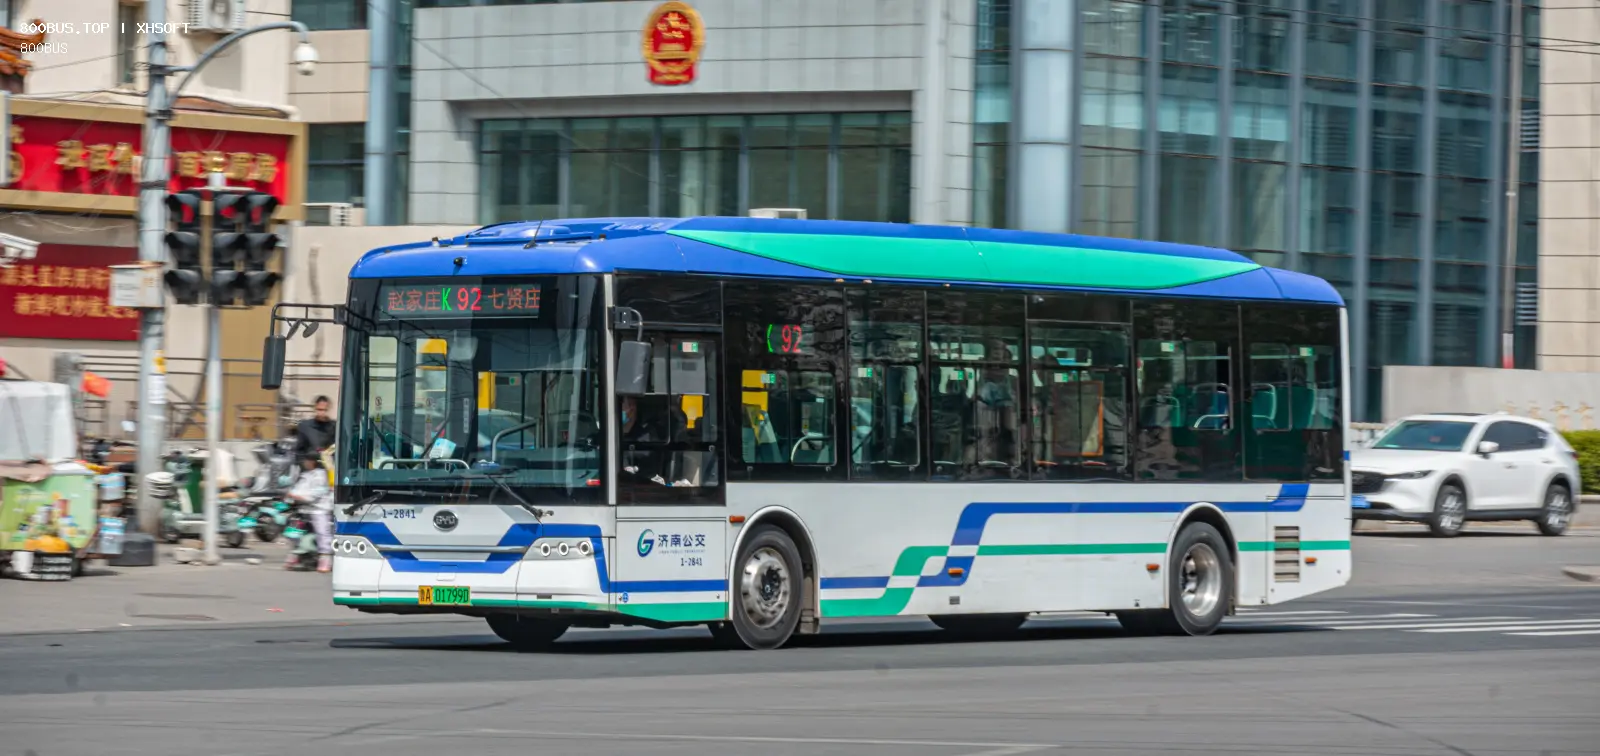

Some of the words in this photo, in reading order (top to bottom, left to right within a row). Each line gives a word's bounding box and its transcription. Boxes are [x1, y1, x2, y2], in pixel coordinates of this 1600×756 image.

[388, 288, 440, 311] 赵家庄
[441, 287, 452, 311] K
[457, 287, 482, 311] 92
[487, 287, 541, 310] 七贤庄
[781, 324, 803, 353] 92
[382, 508, 416, 519] 1-2841
[658, 533, 705, 547] 济南公交
[680, 557, 703, 567] 1-2841
